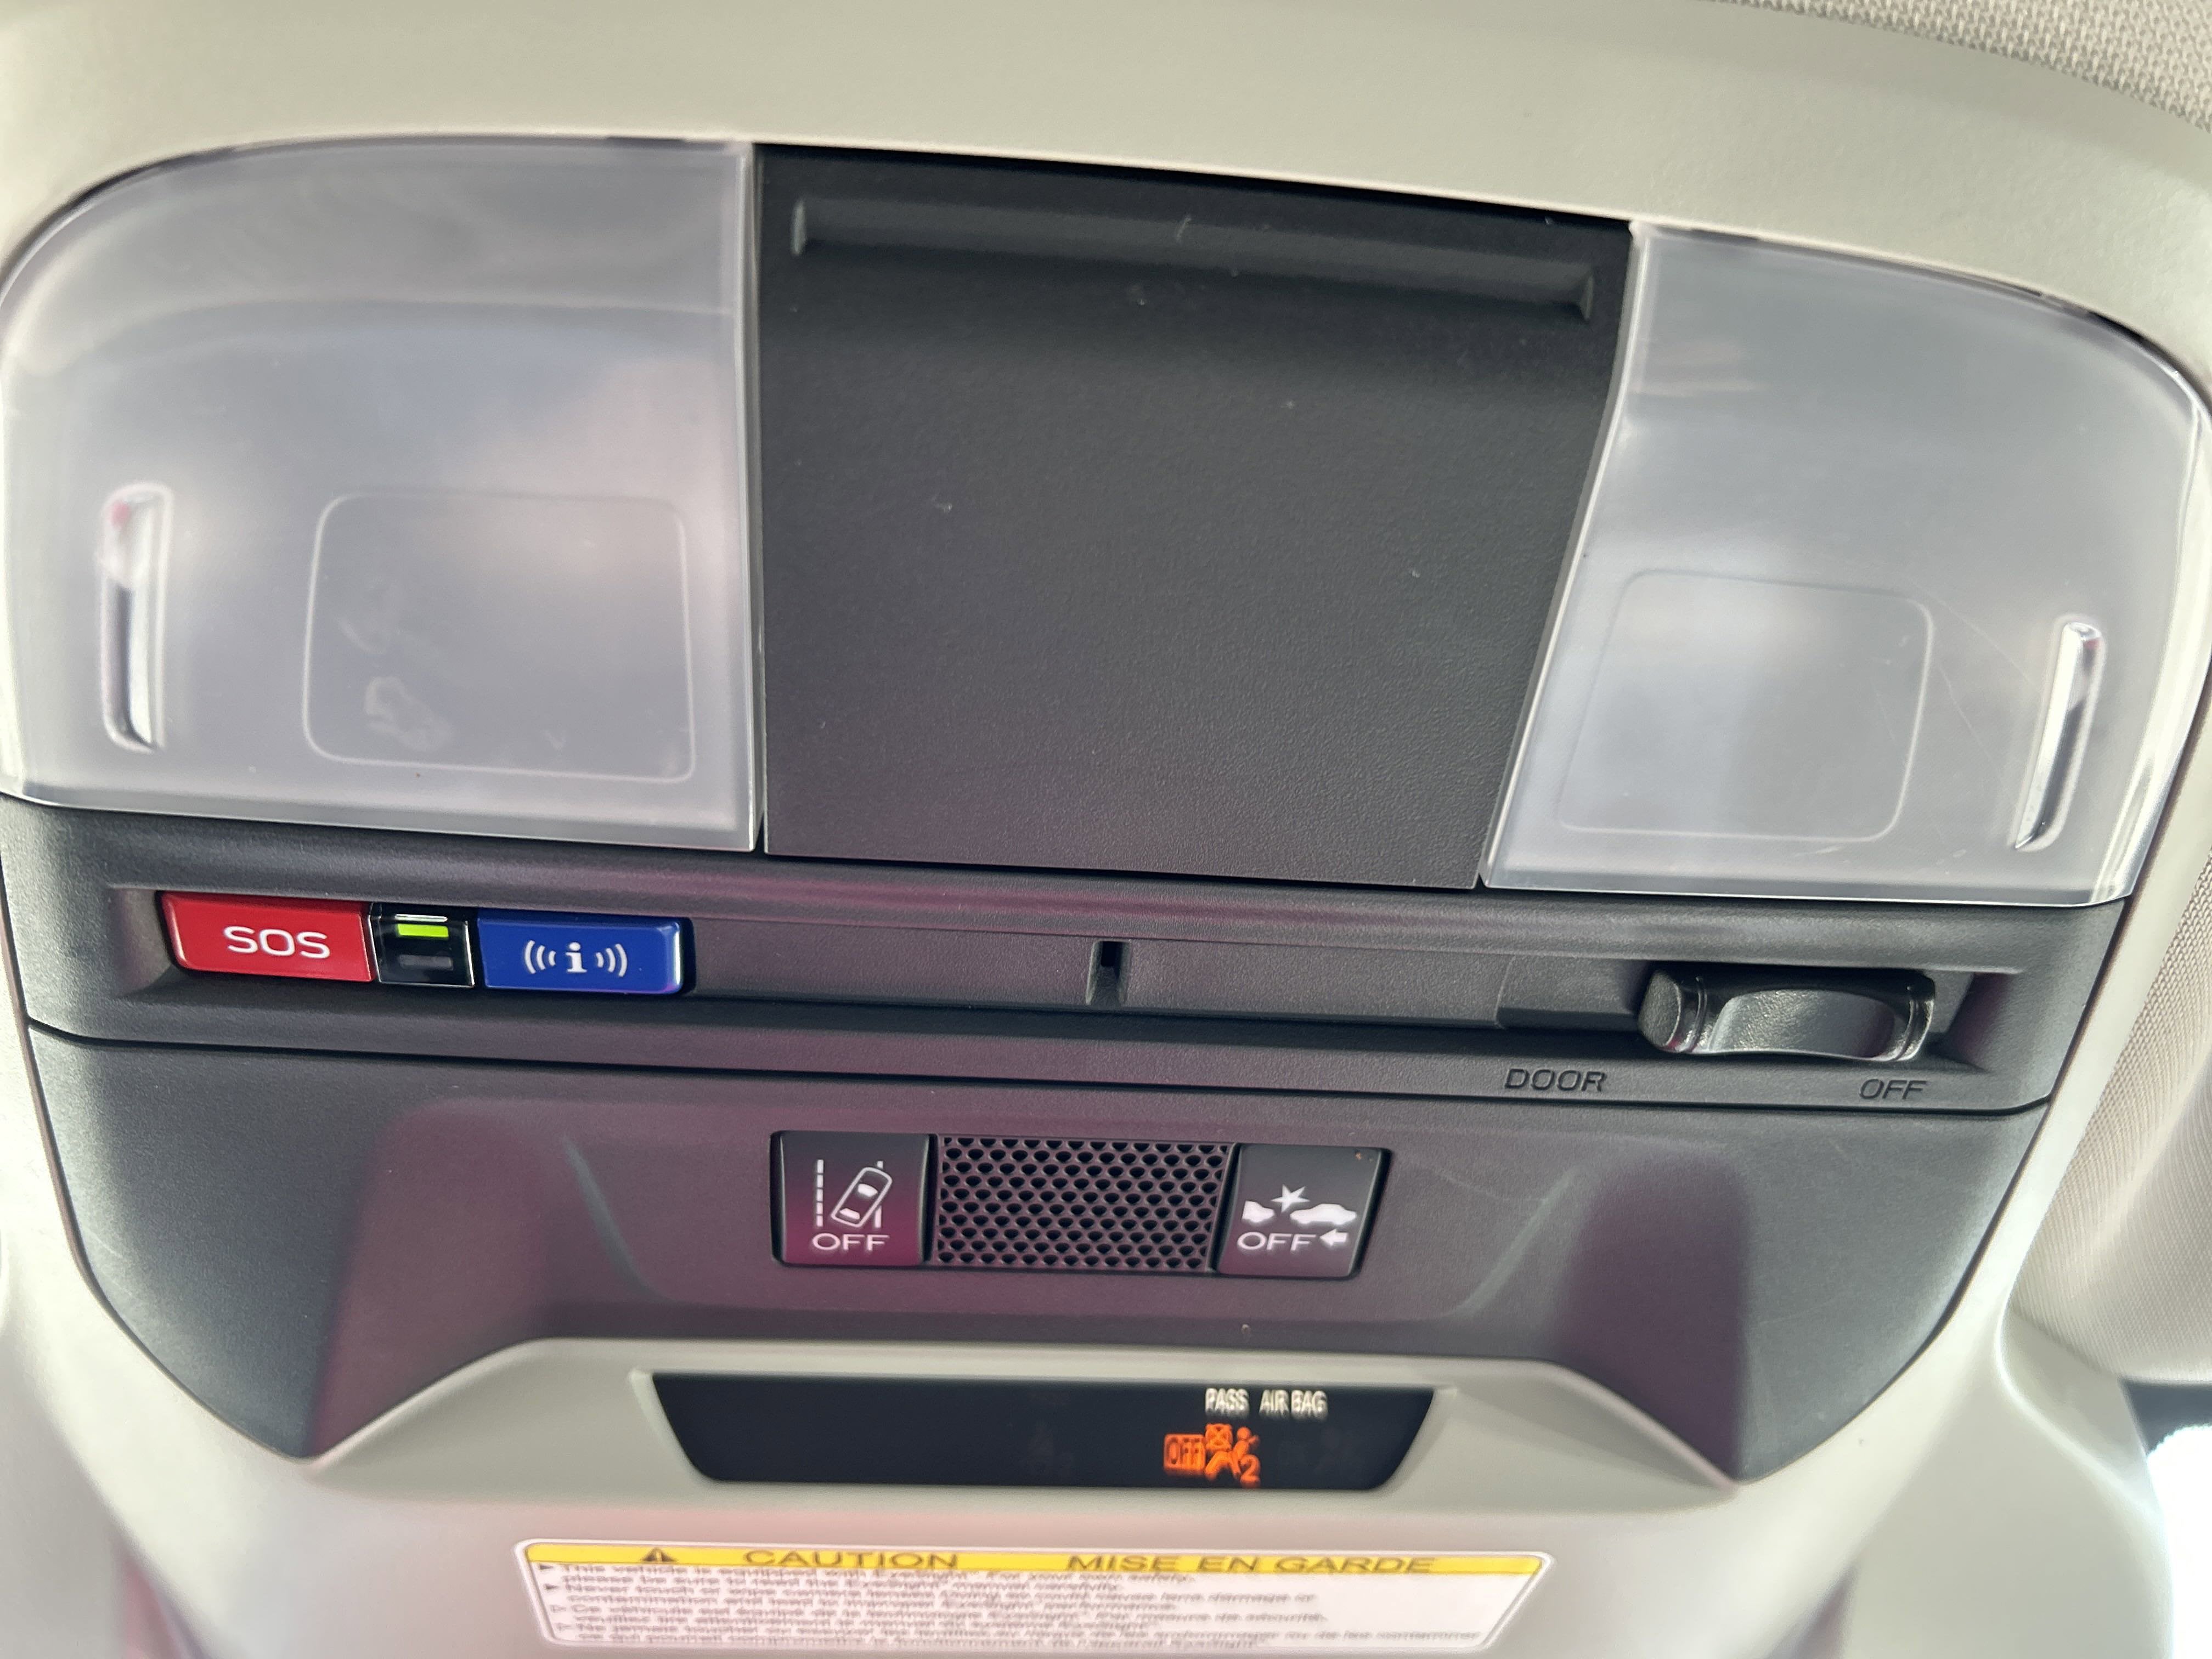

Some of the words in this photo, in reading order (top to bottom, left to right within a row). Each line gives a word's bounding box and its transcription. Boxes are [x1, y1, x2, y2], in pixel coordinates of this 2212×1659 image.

[223, 926, 330, 959] SOS
[1505, 1068, 1607, 1092] DOOR
[1859, 1079, 1927, 1099] OFF
[812, 1232, 889, 1251] OFF
[1238, 1231, 1317, 1251] OFF
[1205, 1387, 1250, 1418] PASS
[1259, 1389, 1289, 1419] AIR
[1291, 1390, 1328, 1420] BAG
[743, 1550, 958, 1569] CAUTION
[1066, 1555, 1178, 1573] MISE
[1197, 1556, 1260, 1573] EN
[1273, 1556, 1436, 1574] GARDE
